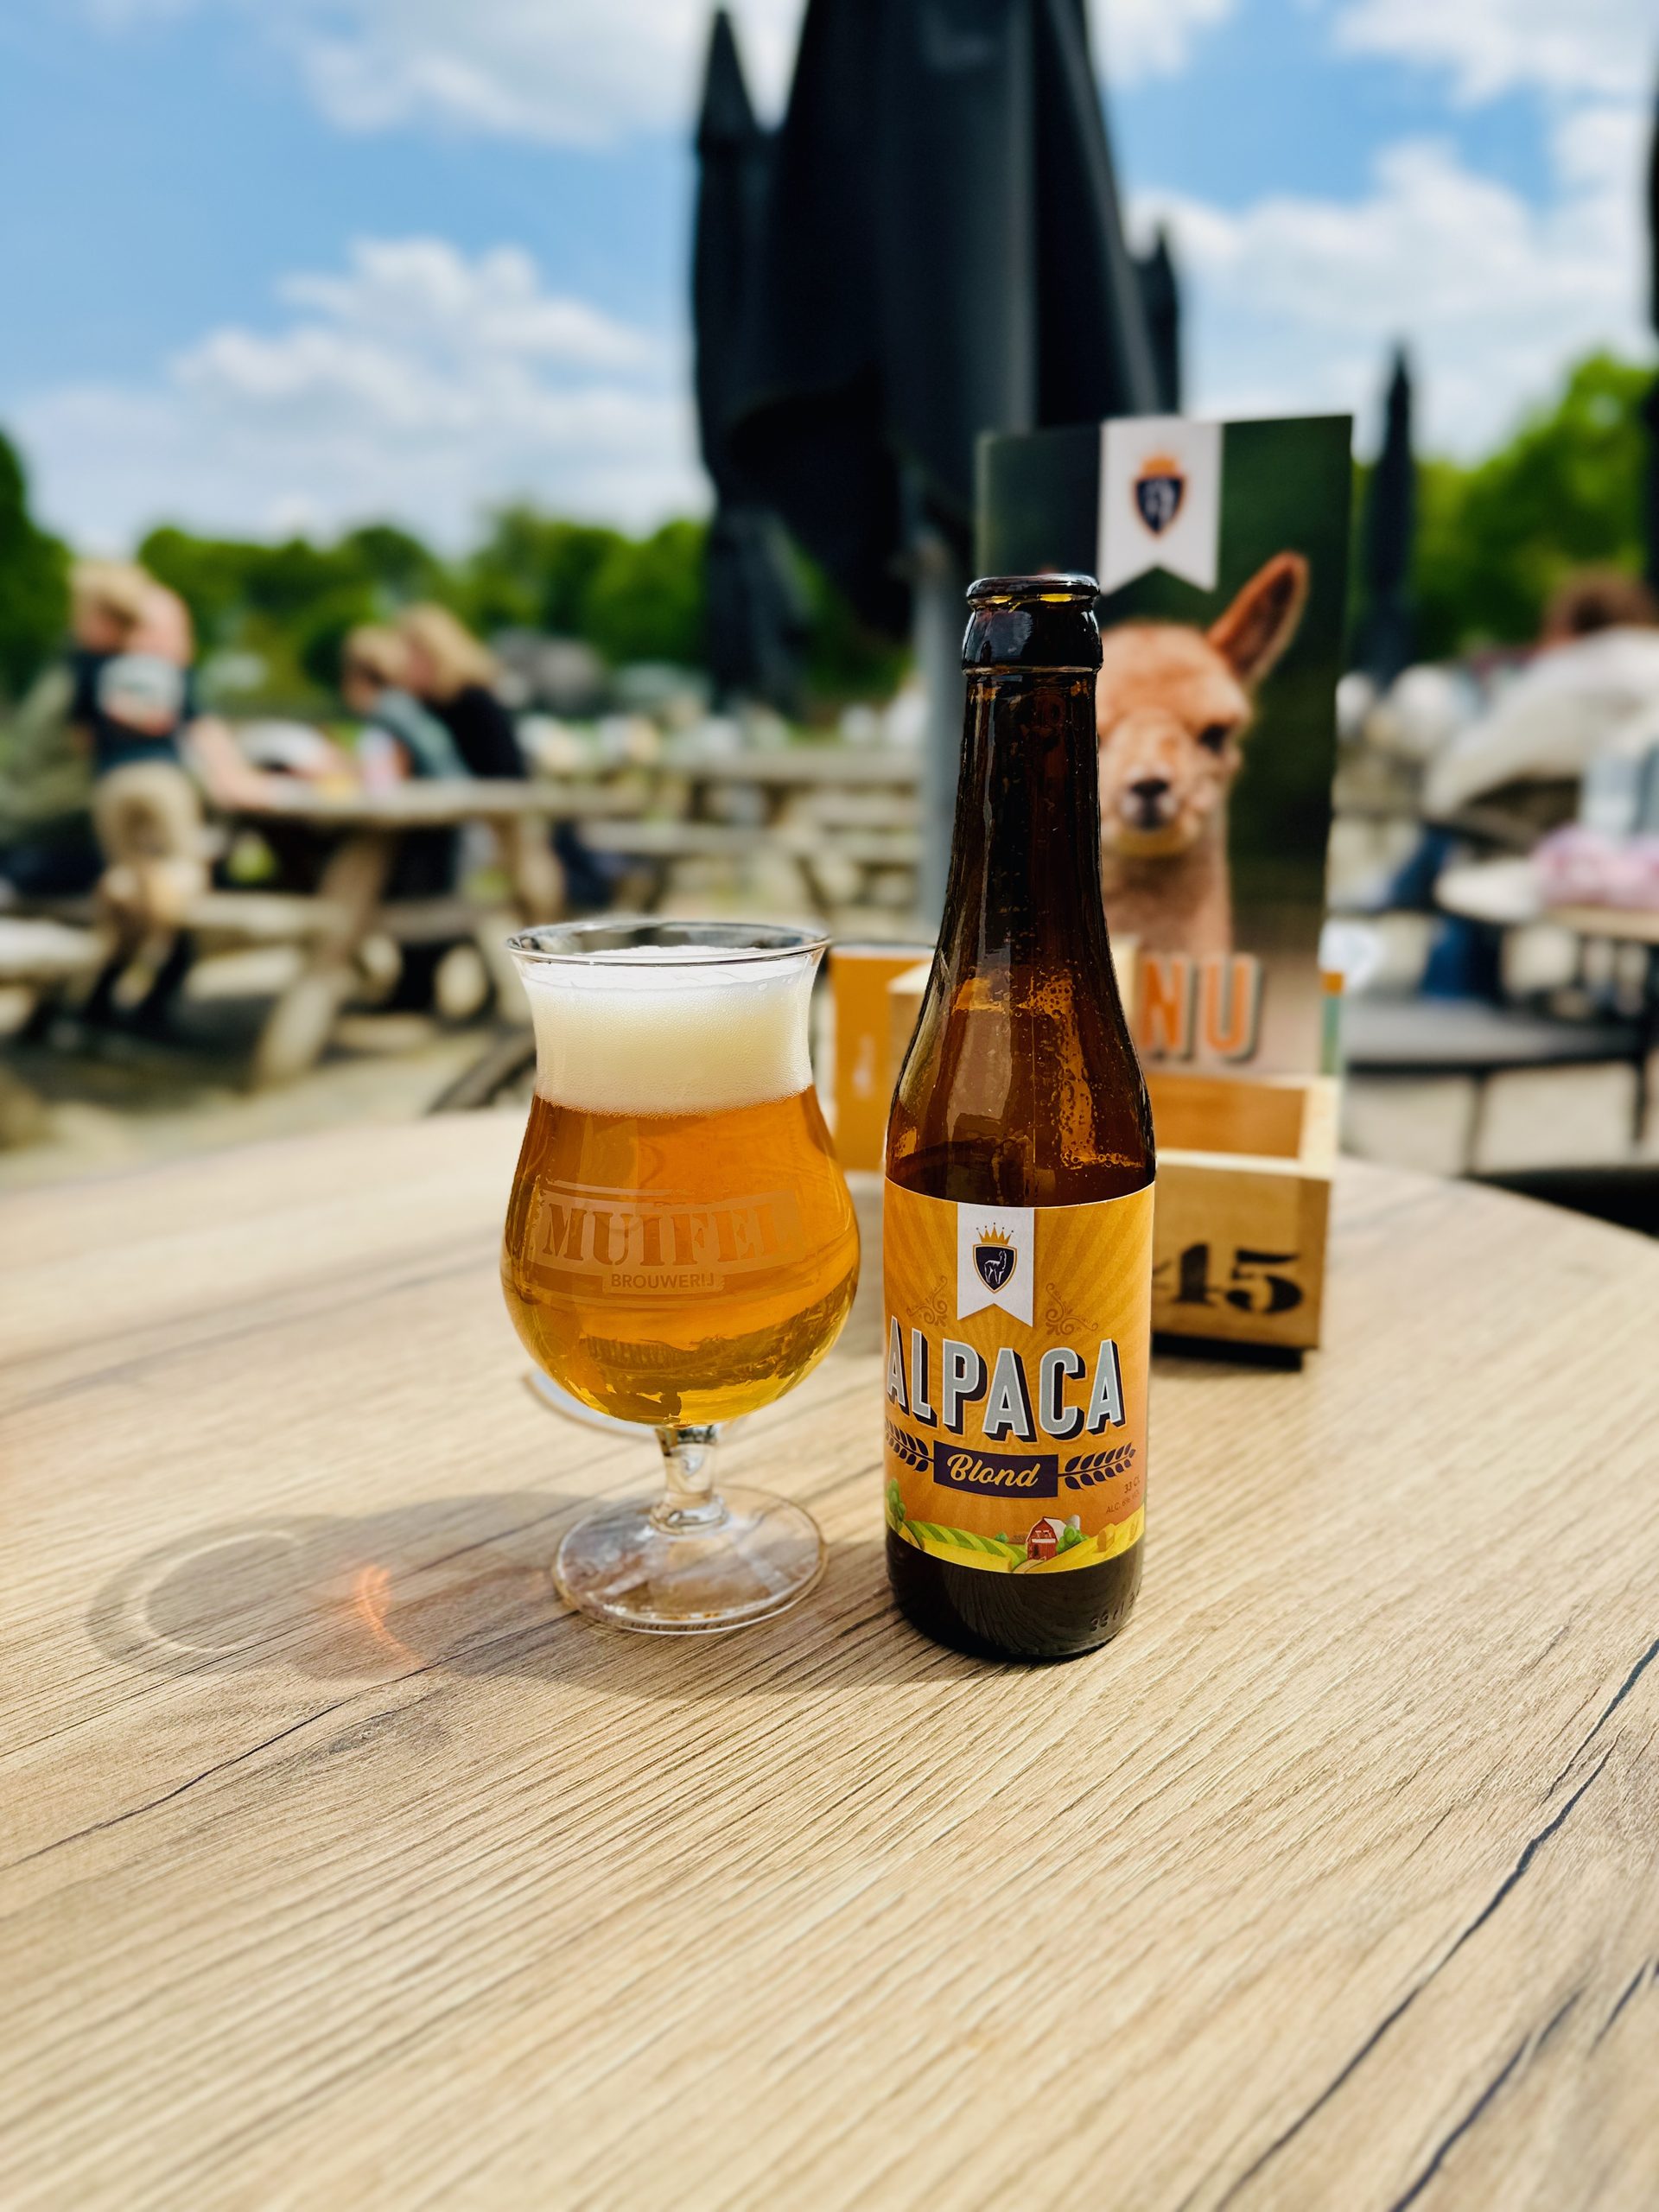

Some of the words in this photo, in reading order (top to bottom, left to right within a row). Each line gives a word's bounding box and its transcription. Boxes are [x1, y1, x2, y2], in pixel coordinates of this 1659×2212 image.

[1138, 954, 1262, 1063] NU
[610, 1272, 715, 1290] BROUWERIJ
[887, 1315, 1126, 1442] ALPACA
[946, 1453, 1040, 1488] Blond
